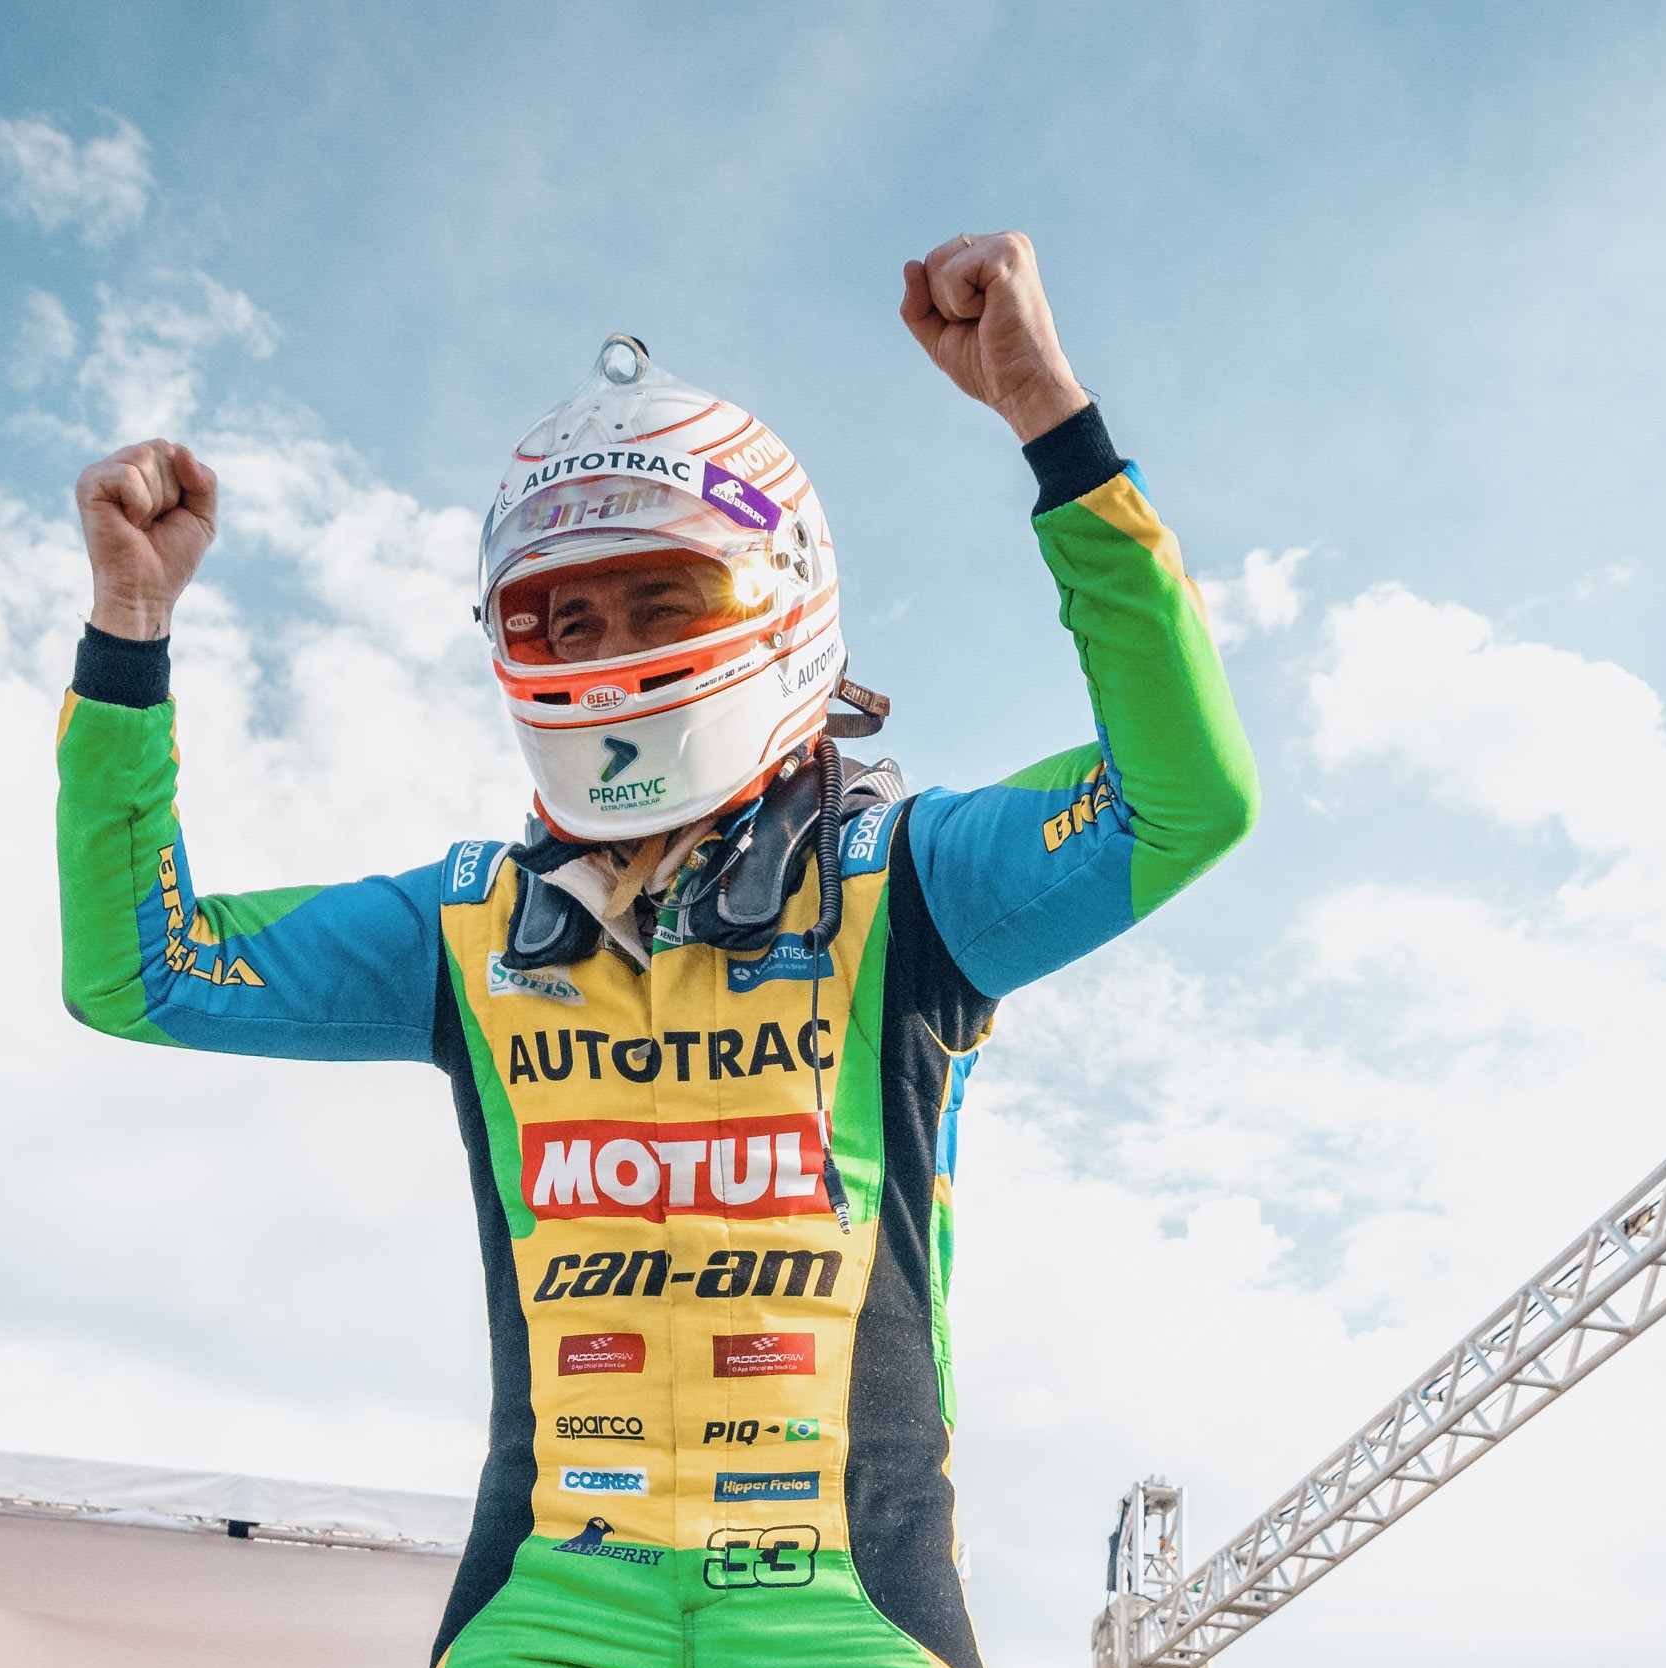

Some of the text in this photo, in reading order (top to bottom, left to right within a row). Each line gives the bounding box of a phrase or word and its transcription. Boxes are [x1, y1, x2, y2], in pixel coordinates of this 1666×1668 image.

[522, 451, 690, 495] AUTOTRAC
[586, 689, 623, 705] BELL
[589, 777, 666, 804] PRATYC
[600, 797, 661, 812] ESTRUTURA SOLAR
[509, 1020, 835, 1084] AUTOTRAC
[532, 1132, 824, 1207] MOTUL
[532, 1248, 843, 1303] can-am
[567, 1352, 634, 1363] PADDOCKFAN
[727, 1352, 805, 1365] PADDOCKFAN
[556, 1415, 645, 1440] sparco
[703, 1420, 760, 1446] PIQ
[722, 1479, 812, 1494] Hipper Freios
[703, 1524, 820, 1590] 33
